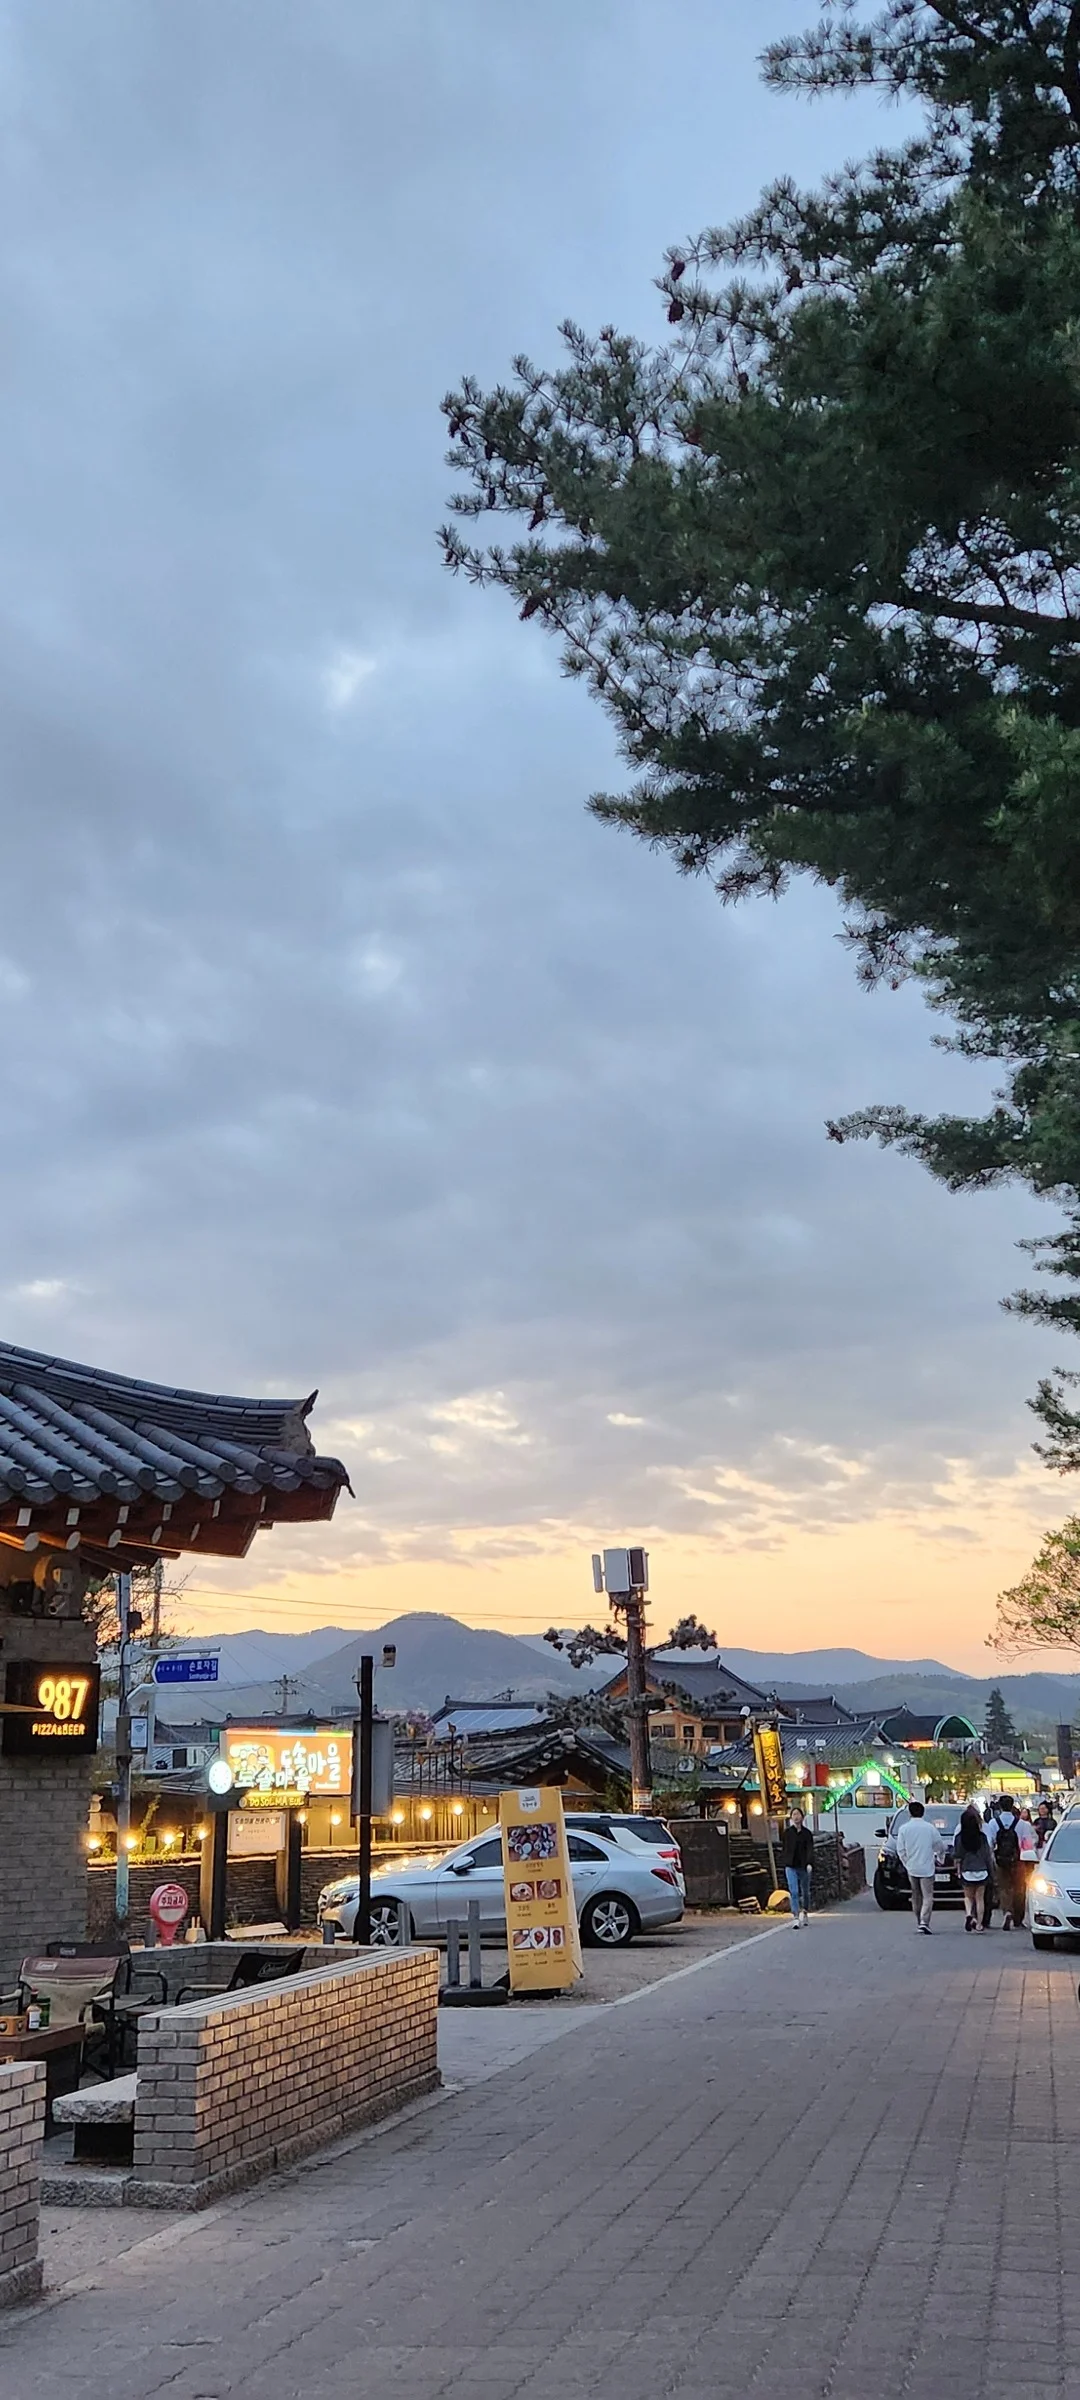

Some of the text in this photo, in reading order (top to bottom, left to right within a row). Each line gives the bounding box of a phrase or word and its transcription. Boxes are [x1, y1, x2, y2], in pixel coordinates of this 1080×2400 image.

[38, 1679, 89, 1720] 987
[32, 1723, 86, 1735] PIZZA&BEER
[234, 1765, 313, 1792] 도솔마을
